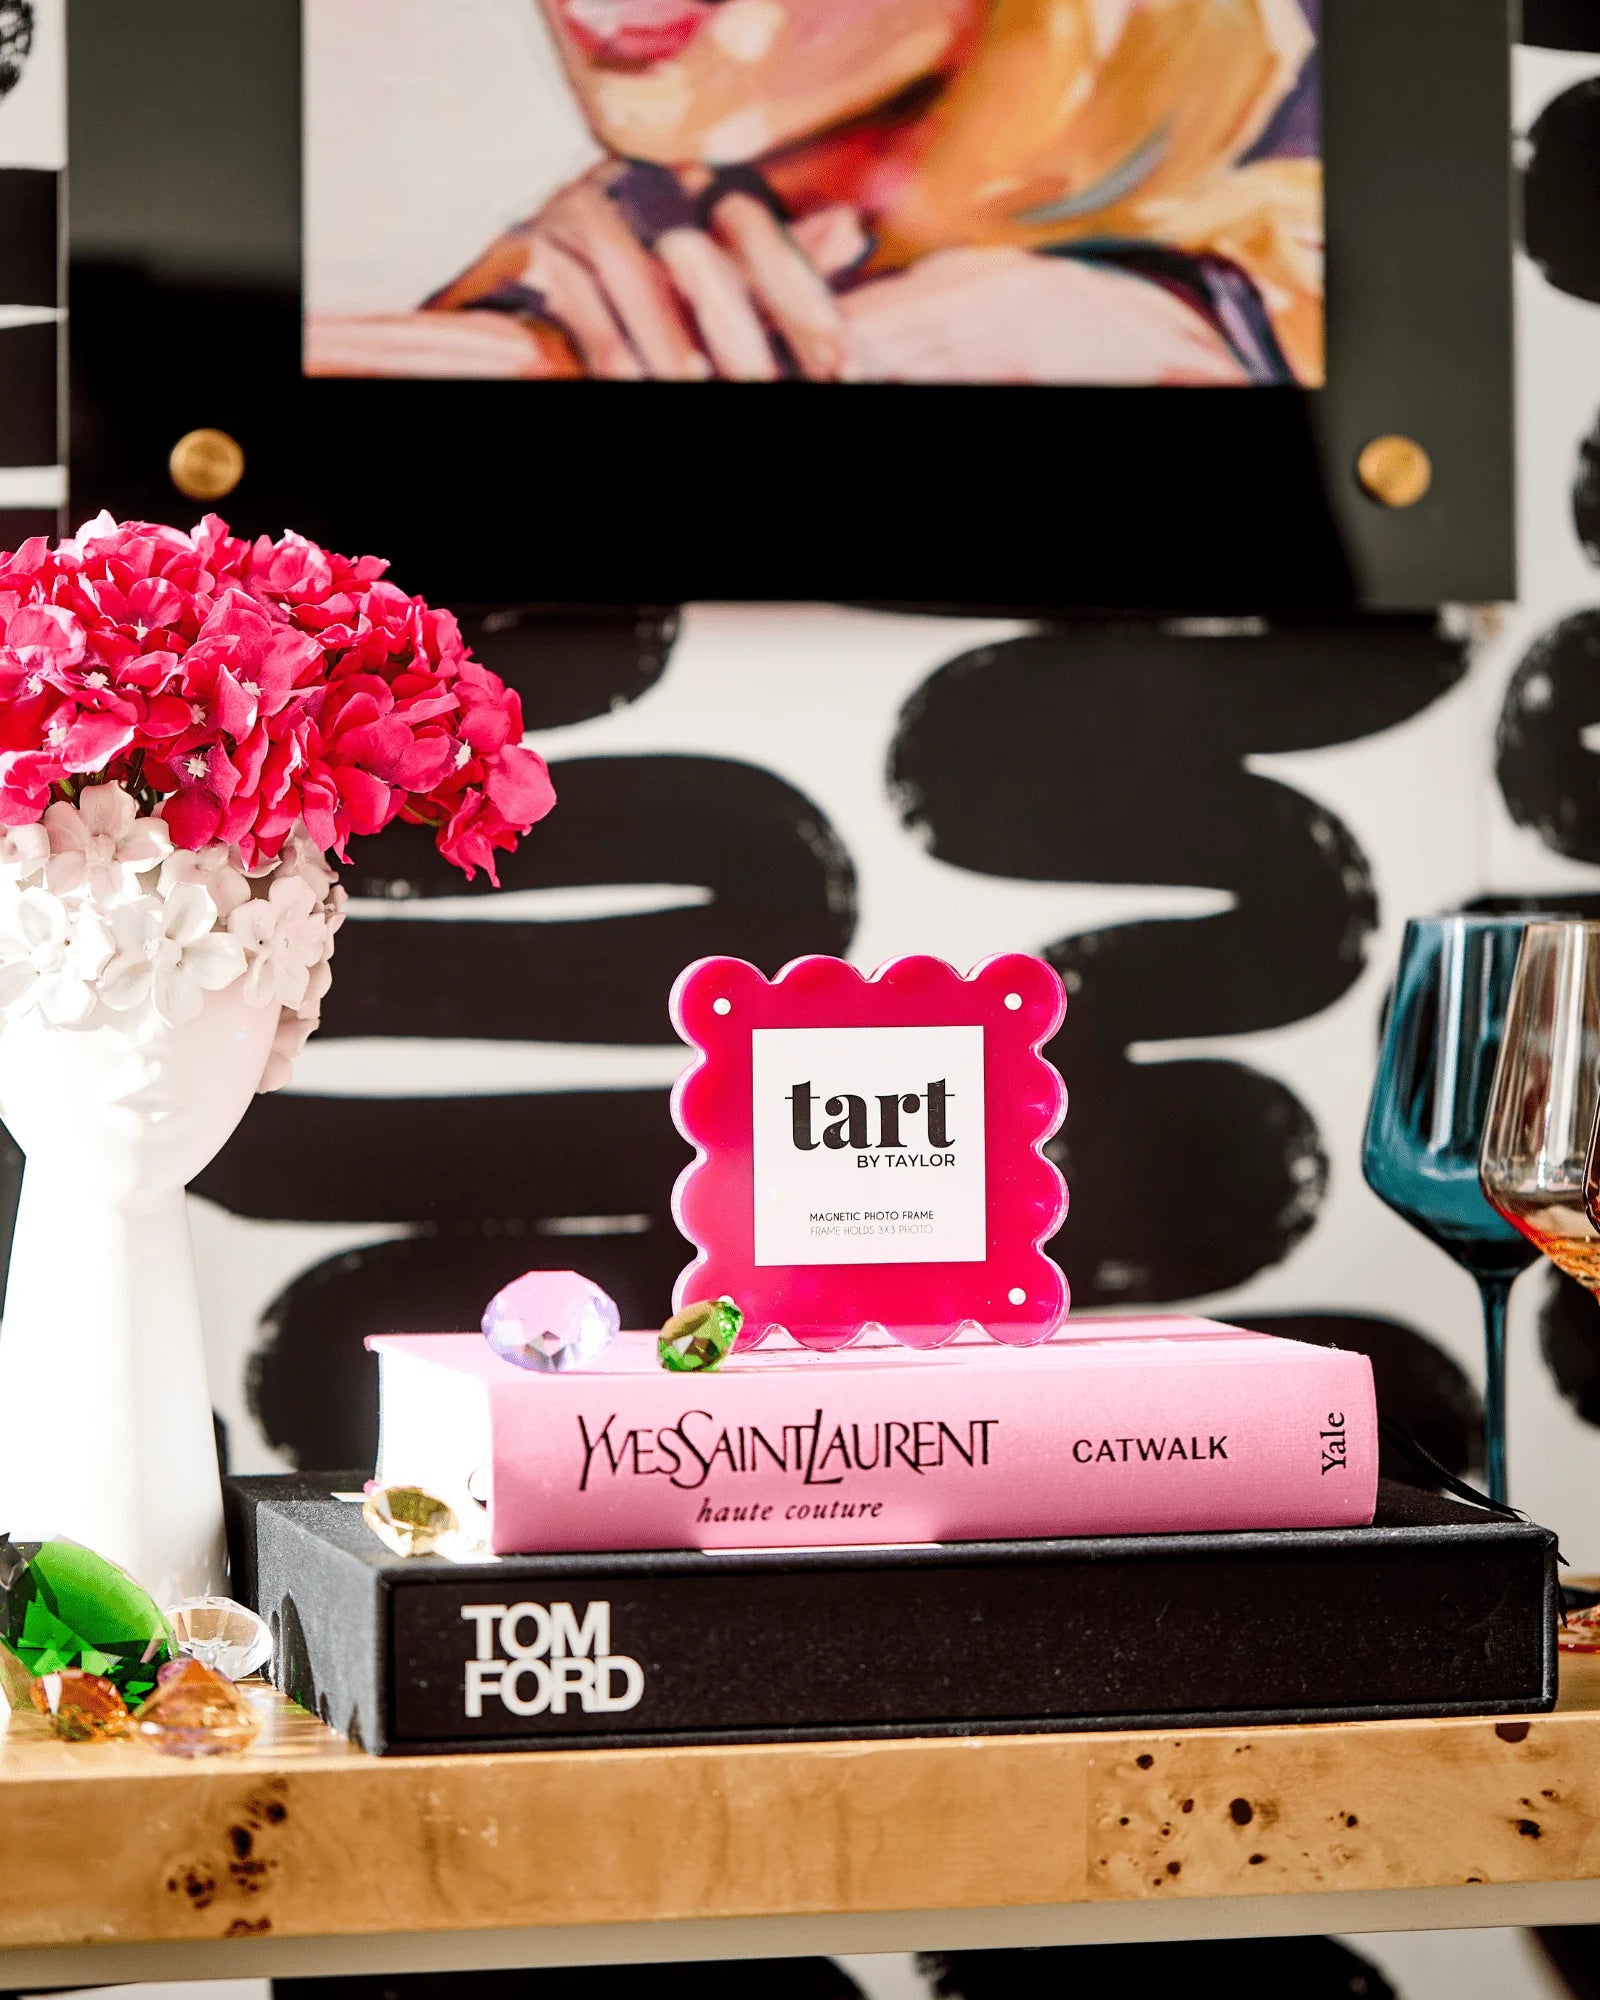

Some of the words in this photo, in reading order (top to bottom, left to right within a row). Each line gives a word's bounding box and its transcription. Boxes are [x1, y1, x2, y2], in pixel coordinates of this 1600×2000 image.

[784, 1078, 956, 1151] tart
[857, 1154, 880, 1169] BY
[884, 1153, 956, 1168] TAYLOR
[809, 1211, 861, 1222] MAGNETIC
[864, 1210, 899, 1221] PHOTO
[902, 1210, 934, 1220] FRAME
[810, 1225, 841, 1236] FRAME
[843, 1225, 875, 1236] HOLDS
[878, 1224, 896, 1235] 3X3
[898, 1223, 934, 1234] PHOTO
[1072, 1435, 1229, 1464] CATWALK
[1319, 1411, 1347, 1476] Yale
[696, 1496, 773, 1523] haute
[784, 1500, 884, 1521] couture
[461, 1601, 611, 1660] TOM
[465, 1655, 645, 1718] FORD
